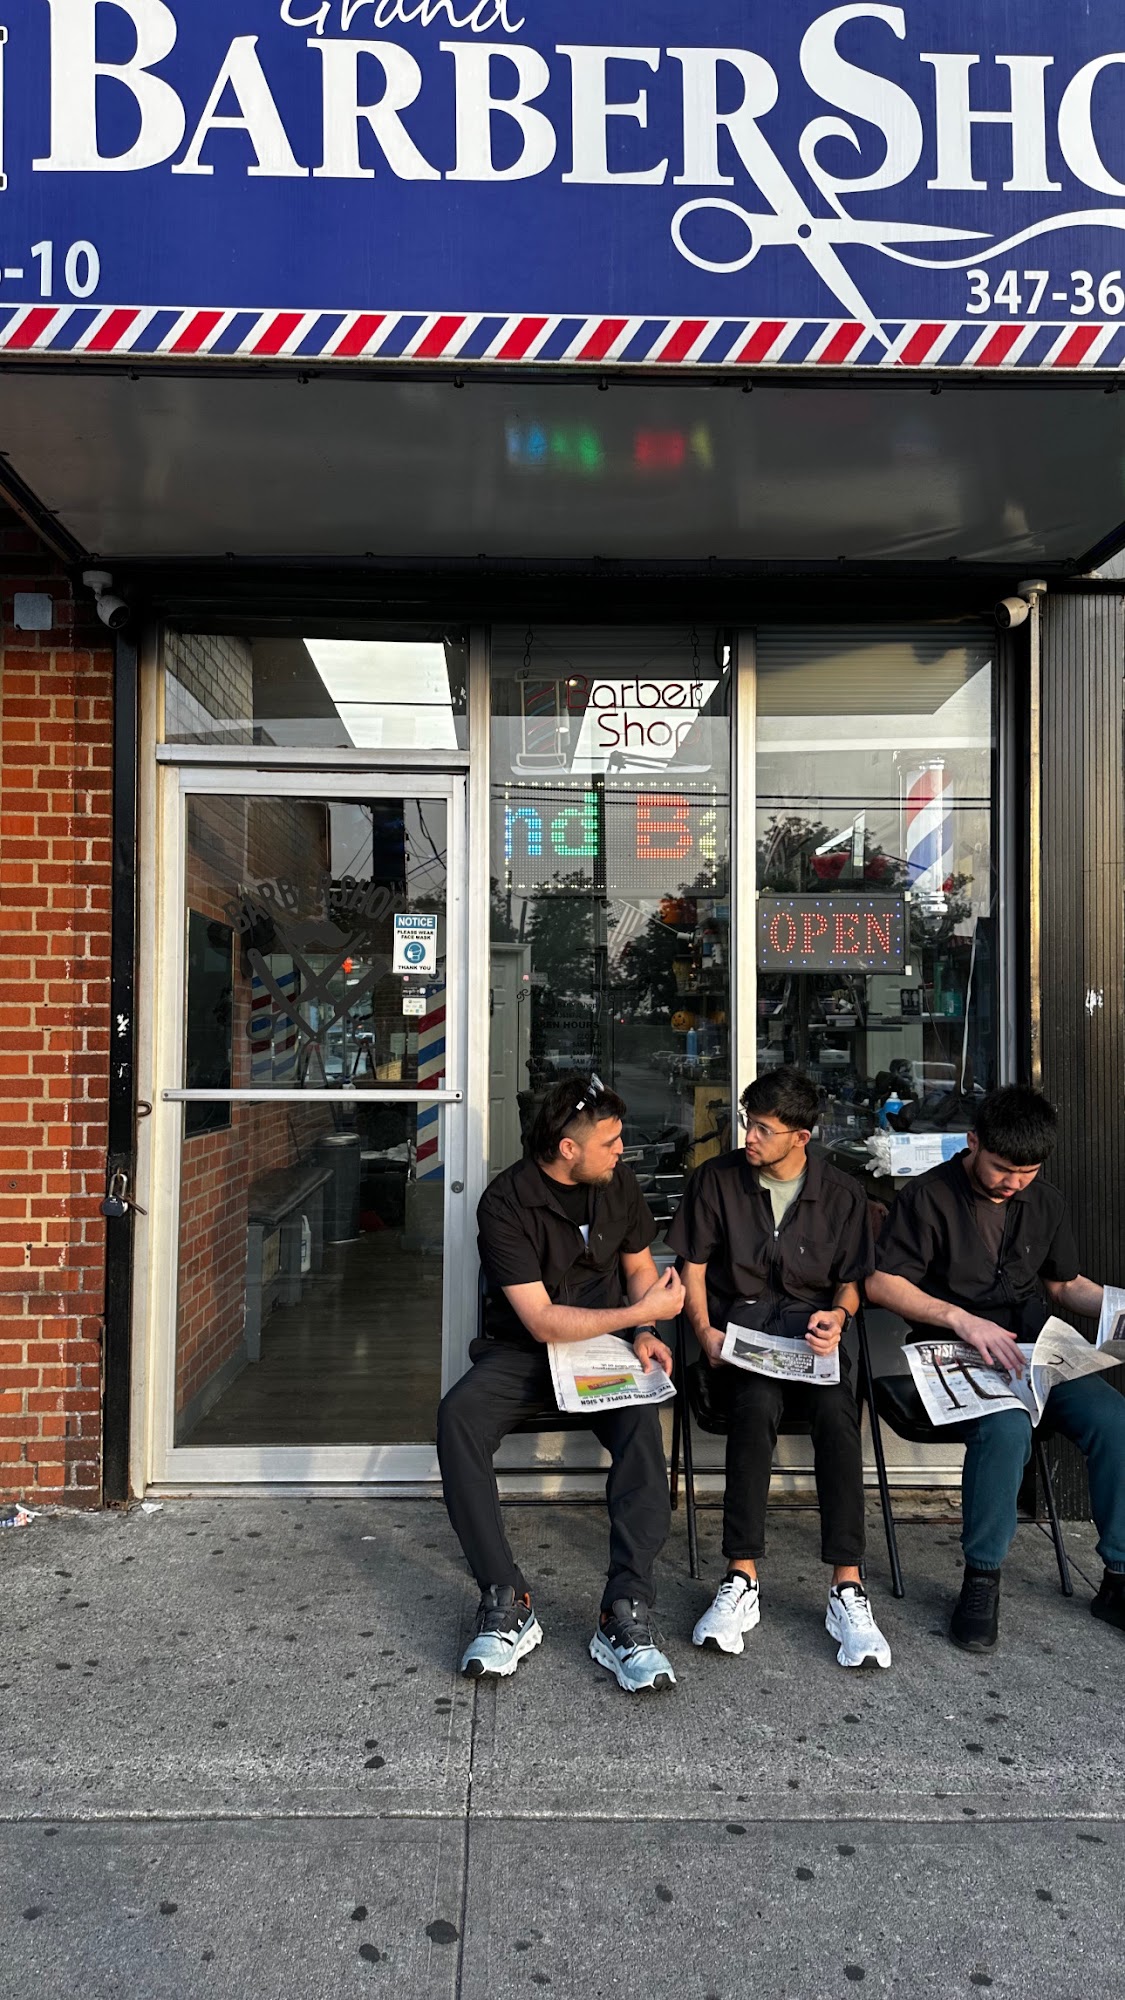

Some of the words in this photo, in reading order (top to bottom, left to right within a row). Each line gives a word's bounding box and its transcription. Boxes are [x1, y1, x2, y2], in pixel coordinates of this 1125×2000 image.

[0, 239, 101, 299] -10
[566, 674, 704, 709] Barber
[597, 711, 702, 748] Shop
[223, 872, 407, 935] BARBRSHOP
[397, 917, 434, 927] NOTICE
[769, 912, 894, 954] OPEN
[562, 1021, 600, 1029] HOURS
[606, 1394, 632, 1402] PEOPLE
[633, 1391, 657, 1399] GIVING
